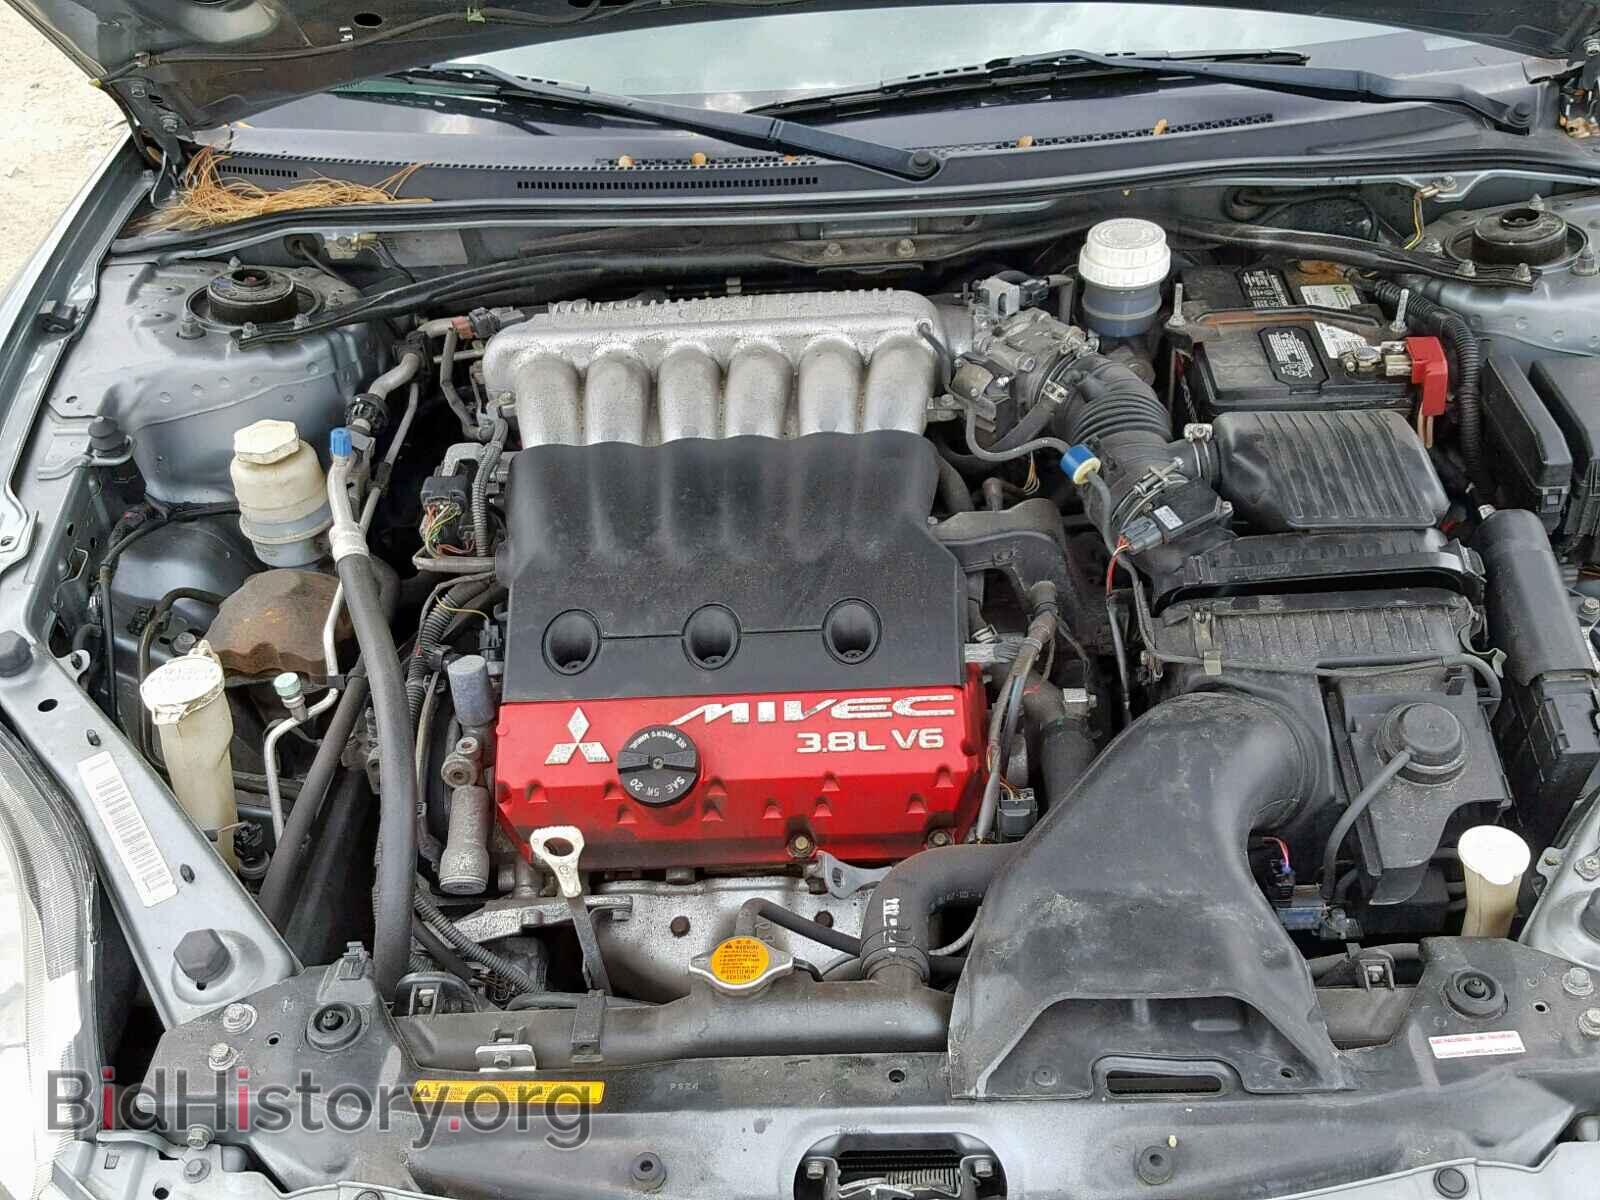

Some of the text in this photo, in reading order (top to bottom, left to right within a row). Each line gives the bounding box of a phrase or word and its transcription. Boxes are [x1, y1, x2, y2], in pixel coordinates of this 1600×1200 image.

[668, 694, 955, 726] MIVEC
[796, 727, 944, 753] 3.8L V6
[664, 775, 686, 794] SAE
